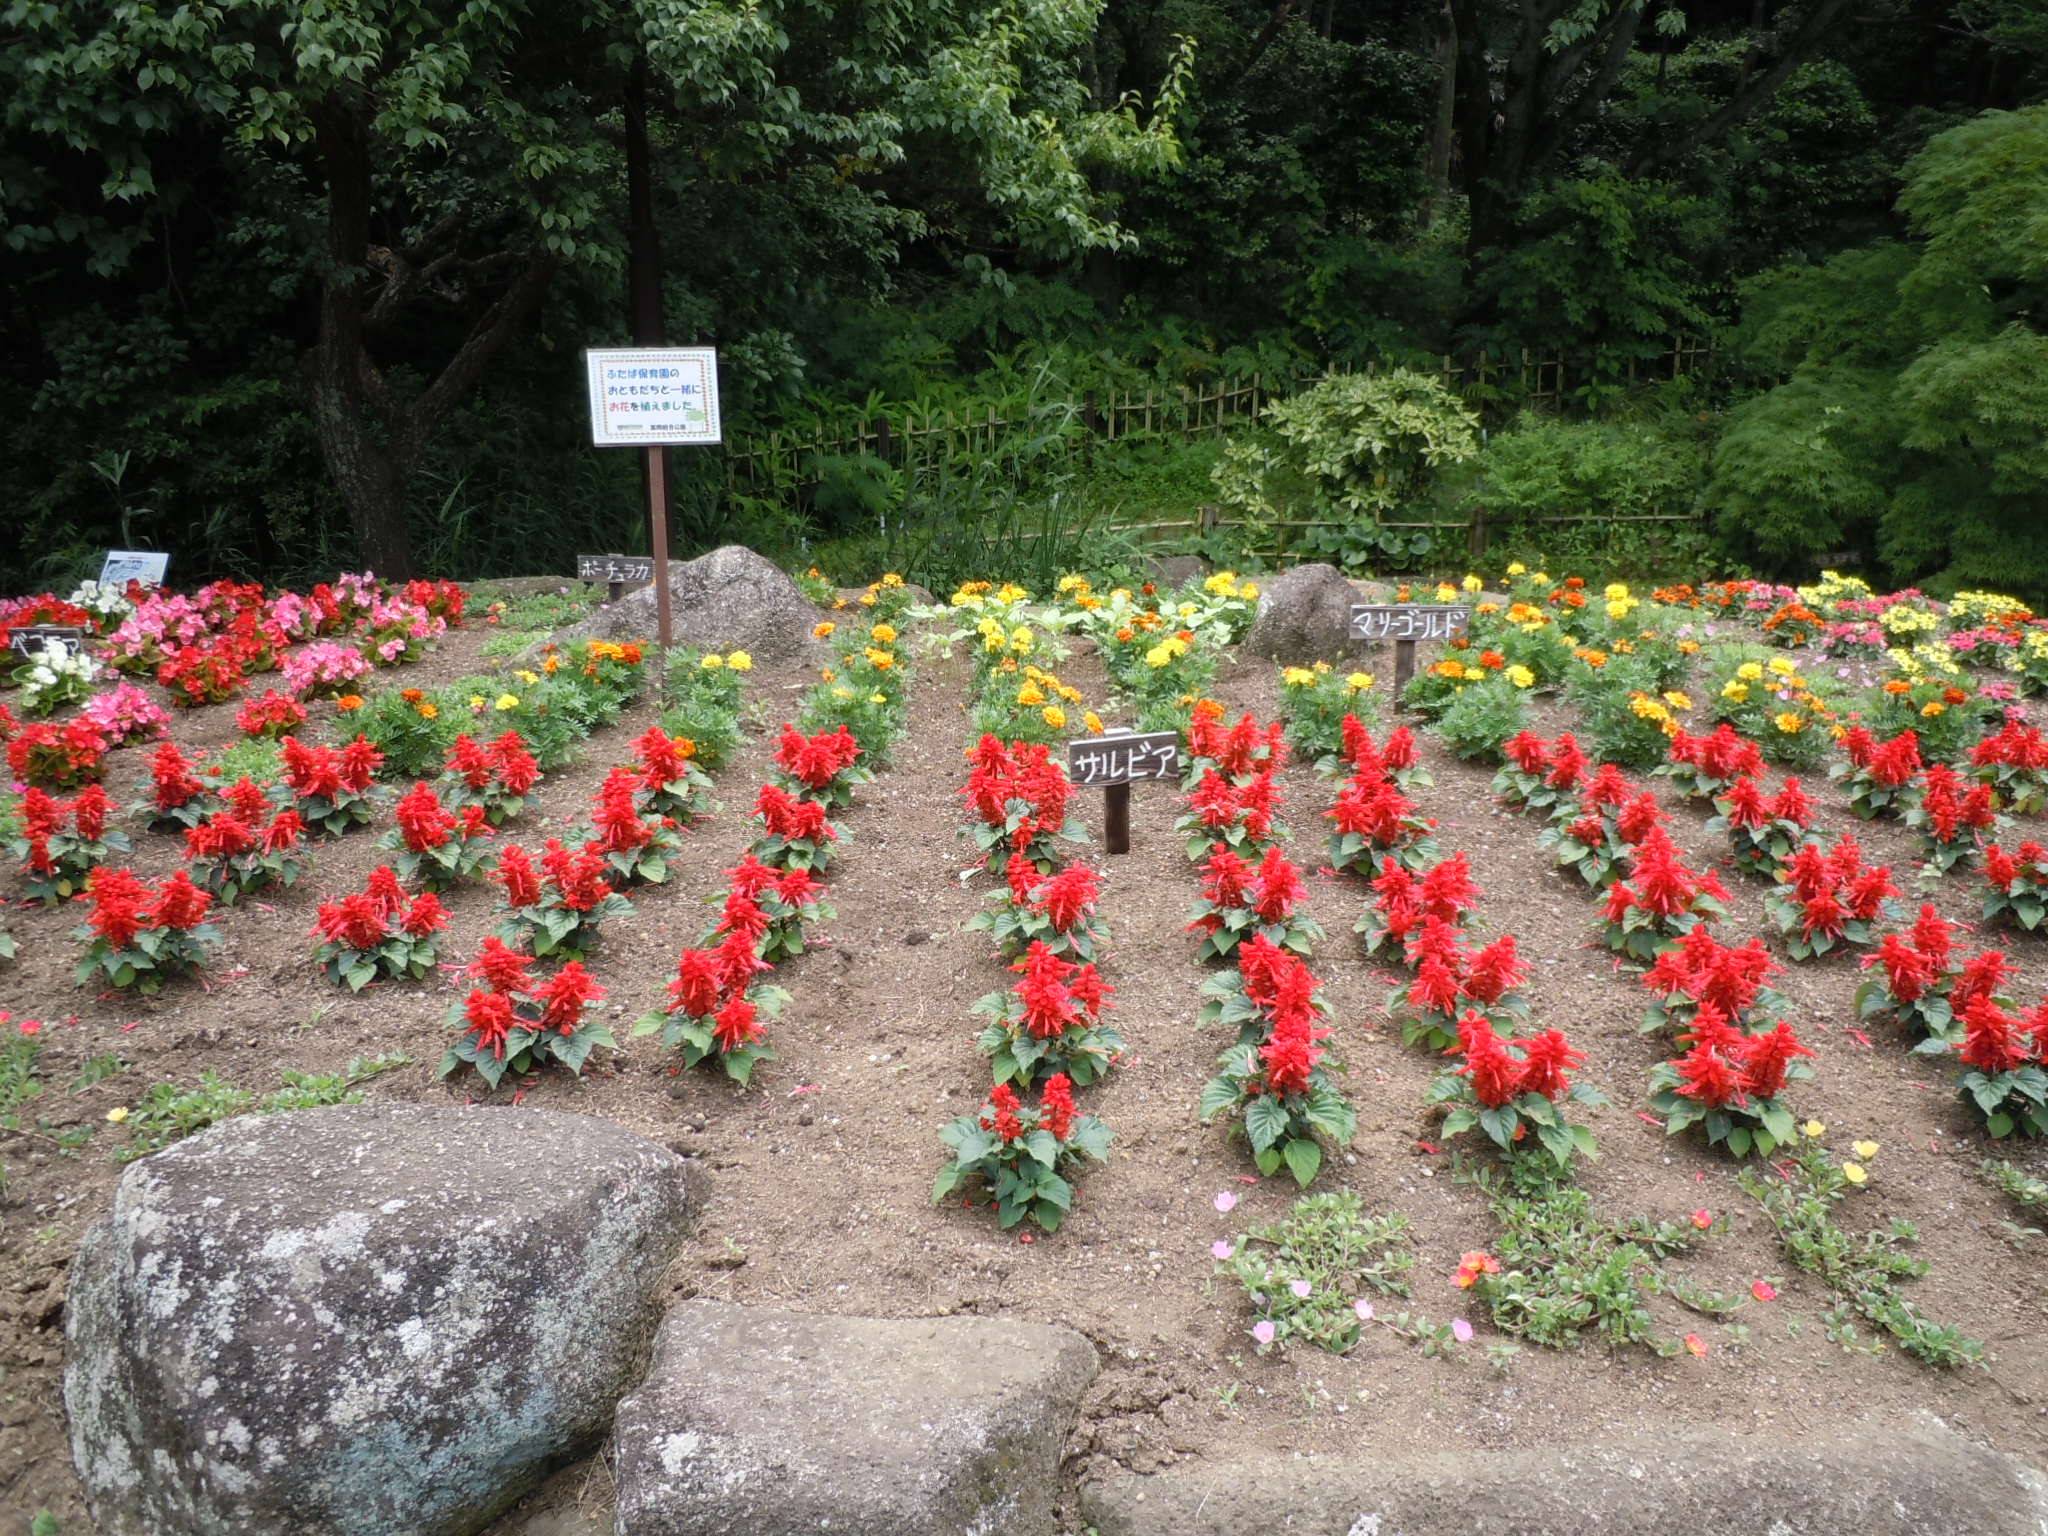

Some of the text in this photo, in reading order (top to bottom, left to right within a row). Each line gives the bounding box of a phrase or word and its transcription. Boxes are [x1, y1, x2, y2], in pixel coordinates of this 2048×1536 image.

[608, 384, 701, 395] おともだちと一緒に
[580, 560, 648, 582] ポーチュラカ
[1353, 609, 1465, 639] マリーゴールド
[1075, 741, 1175, 783] サルビア
